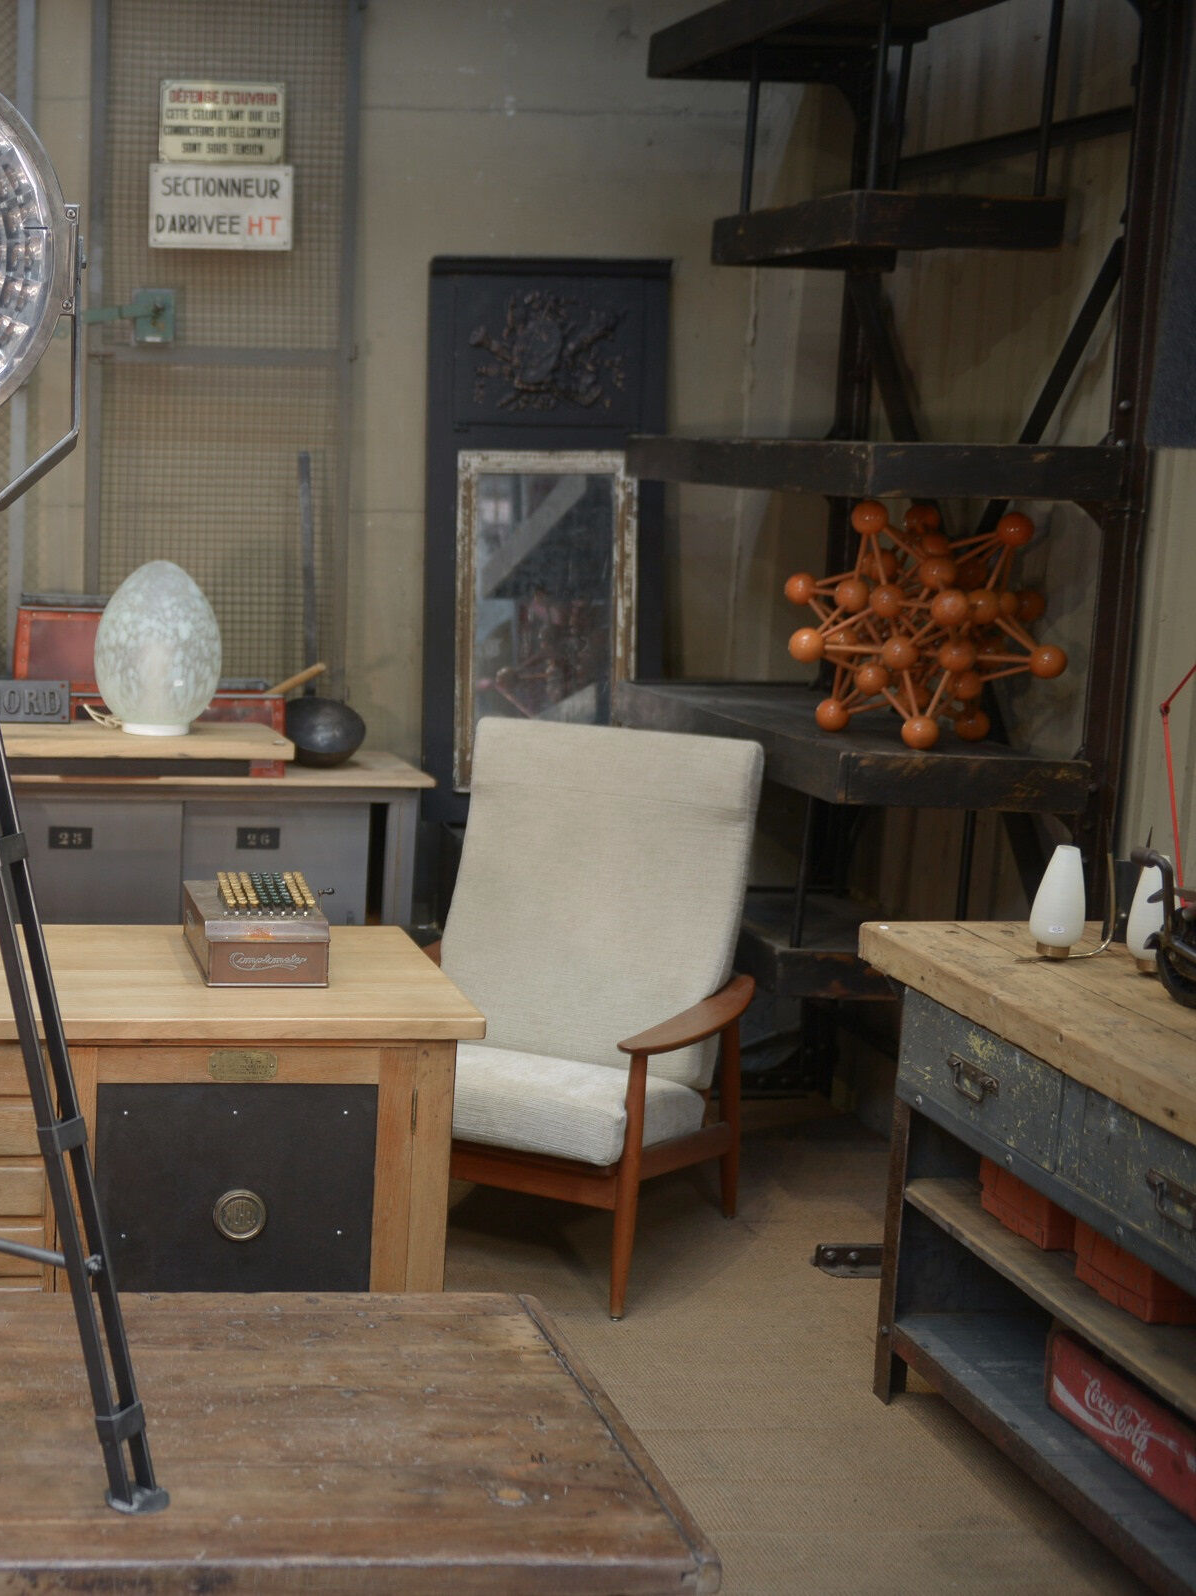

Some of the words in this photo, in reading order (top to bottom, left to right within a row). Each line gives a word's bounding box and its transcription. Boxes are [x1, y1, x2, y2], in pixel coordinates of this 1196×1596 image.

[169, 89, 219, 104] DÉFENSE
[165, 109, 189, 120] CETTE
[192, 109, 223, 121] CELLULE
[226, 110, 244, 121] TANT
[249, 110, 263, 122] QUE
[267, 111, 280, 122] LES
[181, 142, 201, 154] SONT
[206, 143, 228, 155] SOUS
[232, 143, 264, 155] TENSION
[161, 176, 280, 199] SECTIONNEUR
[247, 216, 281, 236] HT
[58, 832, 83, 845] 25
[246, 832, 271, 846] 26
[229, 952, 308, 971] Comptometer
